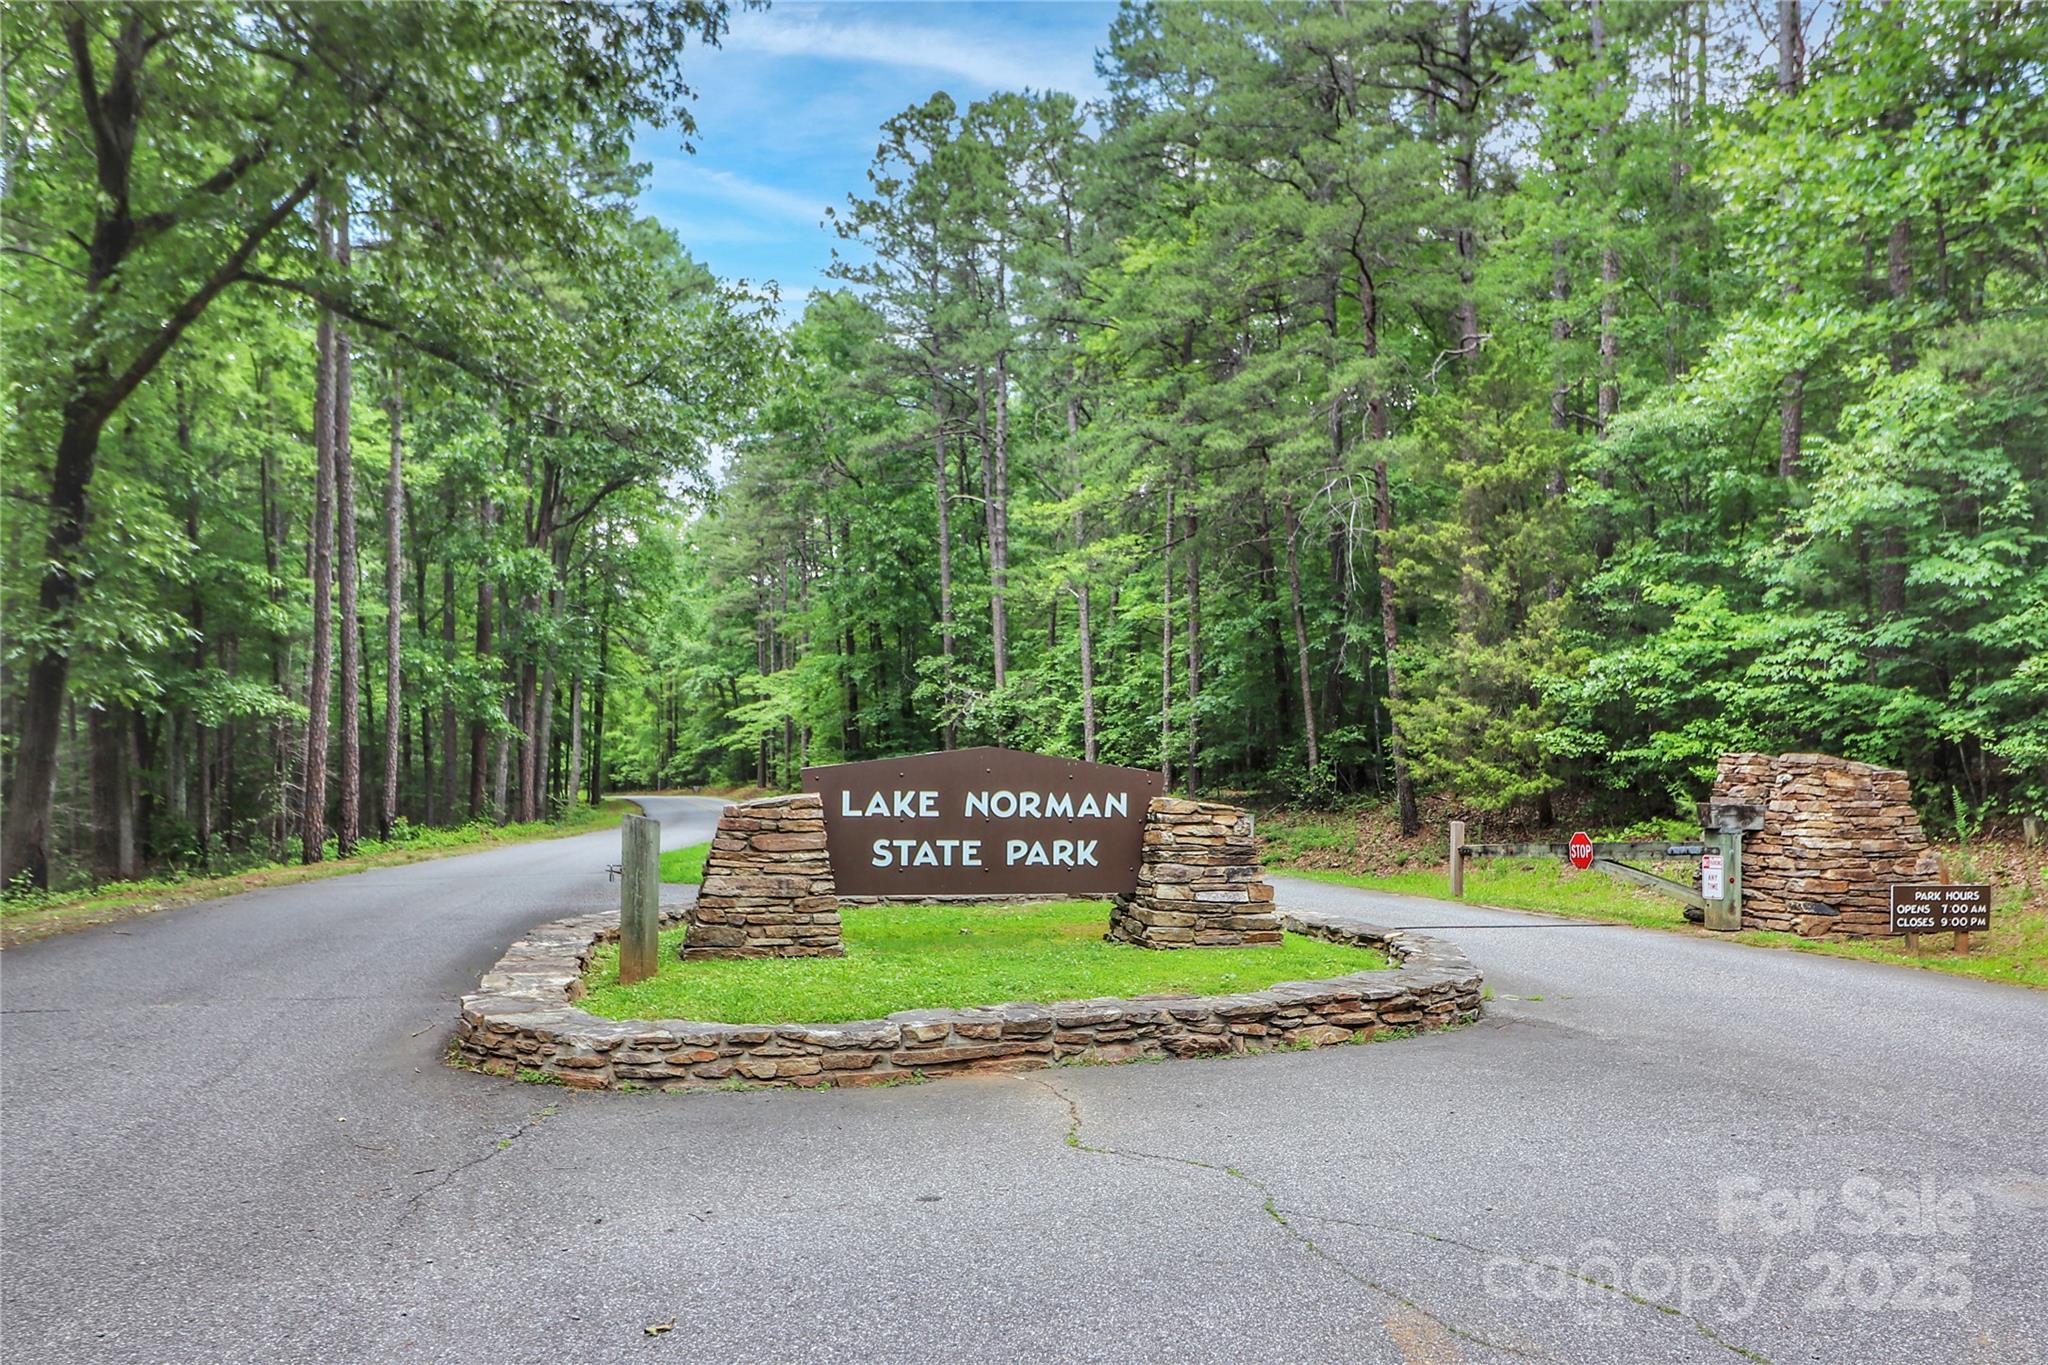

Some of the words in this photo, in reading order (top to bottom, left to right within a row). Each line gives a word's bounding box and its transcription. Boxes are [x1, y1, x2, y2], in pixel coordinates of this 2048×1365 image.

[842, 791, 939, 817] LAKE
[965, 791, 1128, 818] NORMAN
[872, 839, 982, 867] STATE
[1006, 839, 1099, 867] PARK
[1571, 844, 1591, 858] STOP
[1915, 891, 1941, 900] PARK
[1945, 891, 1980, 900] HOURS
[1896, 904, 1931, 914] OPENS
[1970, 905, 1987, 913] AM
[1896, 917, 1935, 927] CLOSES
[1940, 917, 1968, 927] 9:00
[1970, 917, 1986, 926] PM
